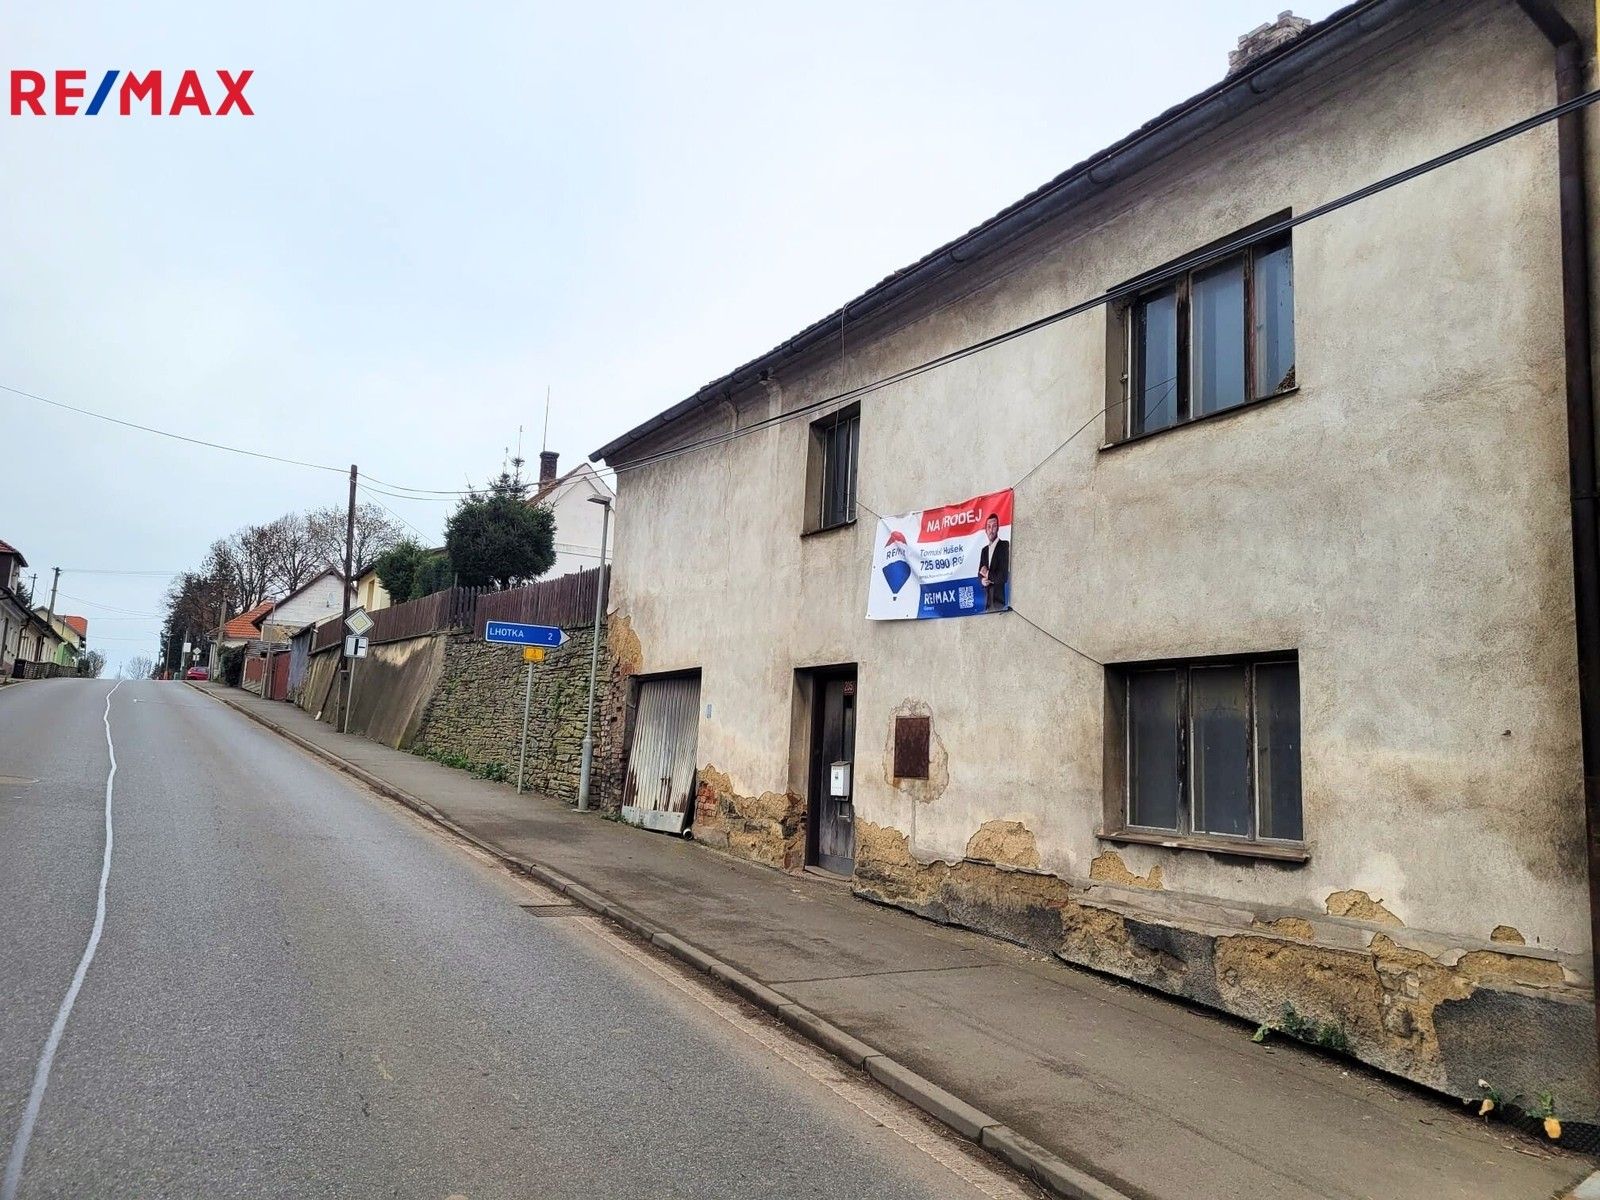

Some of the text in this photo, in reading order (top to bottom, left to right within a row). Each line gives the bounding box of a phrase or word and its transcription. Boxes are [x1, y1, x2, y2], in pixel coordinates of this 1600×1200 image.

[926, 508, 982, 533] NA RODEJ
[920, 560, 934, 571] 725
[935, 558, 951, 570] 890
[924, 590, 956, 605] RE/MAX
[489, 627, 553, 641] LHOTKA 2
